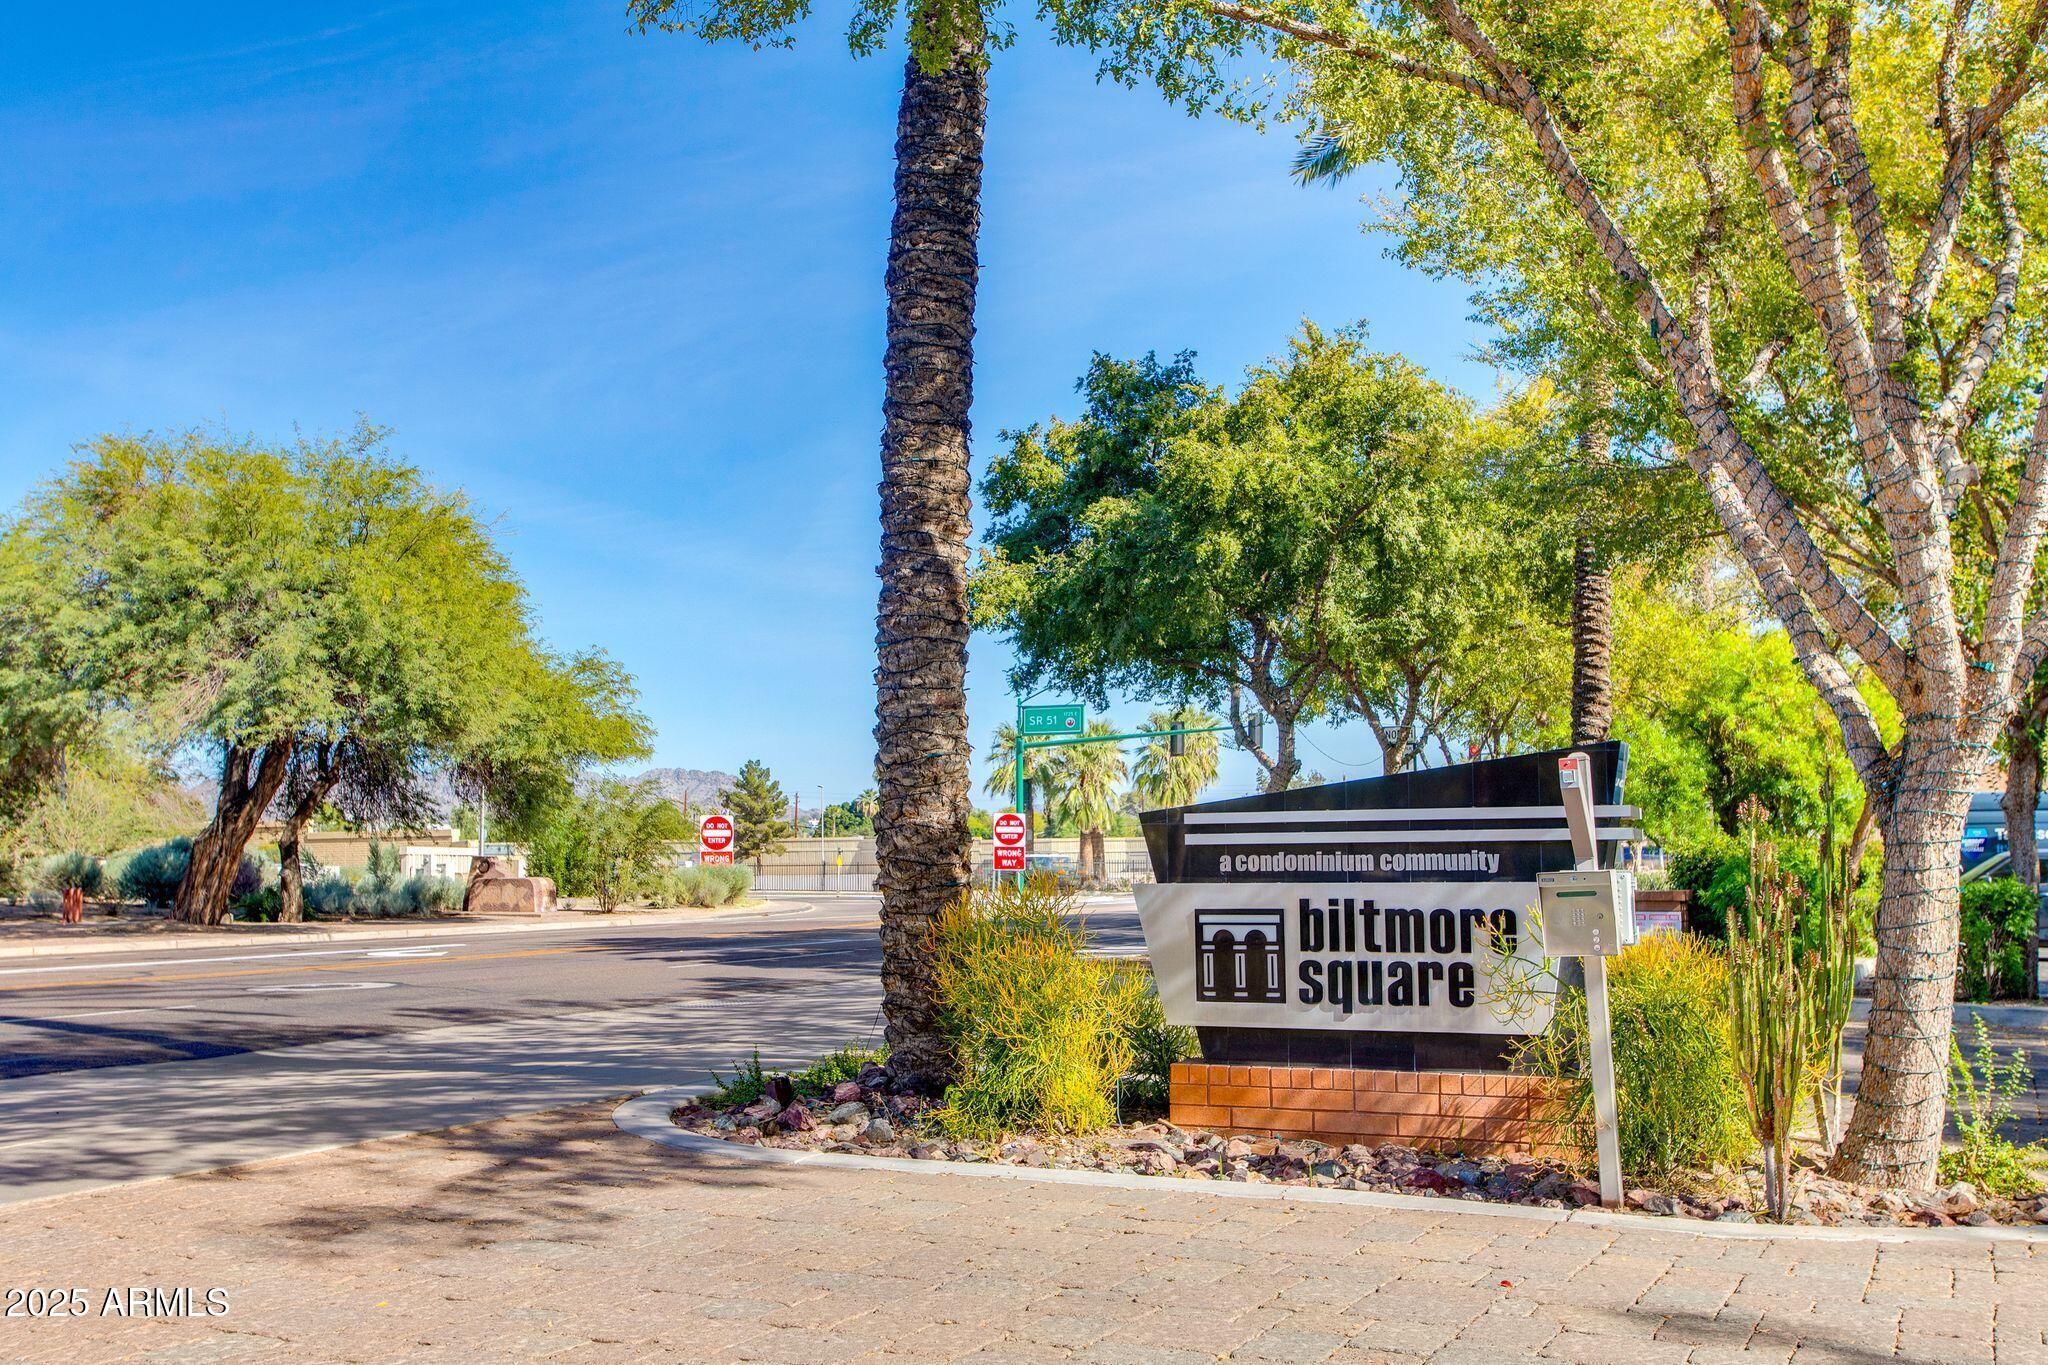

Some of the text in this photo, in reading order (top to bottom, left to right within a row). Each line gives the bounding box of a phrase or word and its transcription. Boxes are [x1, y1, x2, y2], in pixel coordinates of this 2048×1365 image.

[1029, 715, 1057, 726] SR 51
[704, 854, 730, 863] WRONG
[997, 849, 1022, 857] WRONG
[1002, 859, 1017, 867] WAY
[1219, 850, 1500, 873] a condominium community
[1299, 898, 1518, 955] biltmore
[1298, 959, 1475, 1014] square
